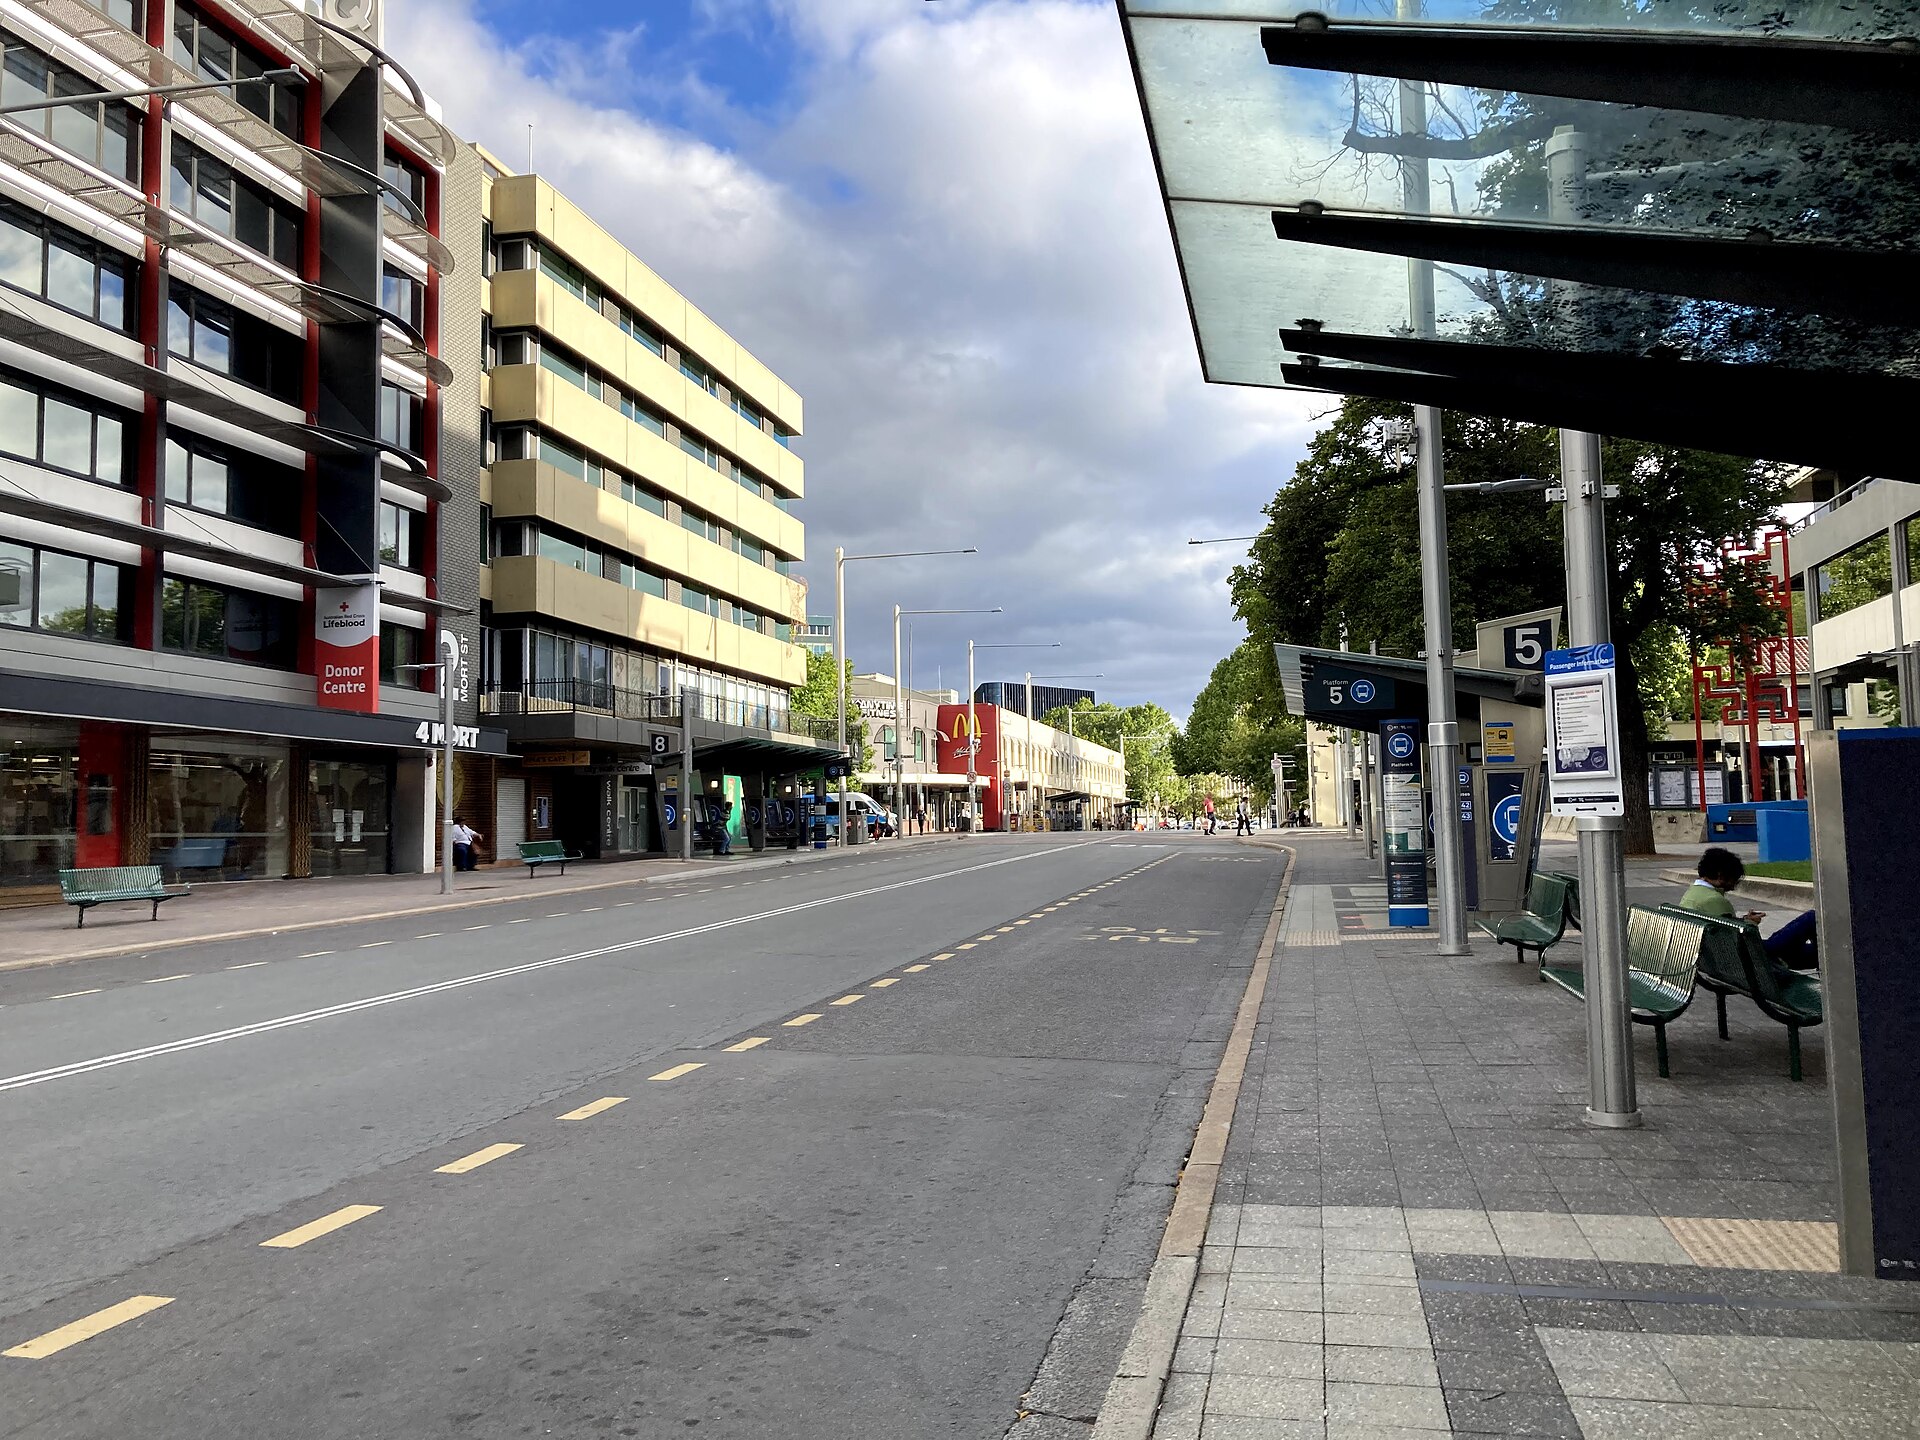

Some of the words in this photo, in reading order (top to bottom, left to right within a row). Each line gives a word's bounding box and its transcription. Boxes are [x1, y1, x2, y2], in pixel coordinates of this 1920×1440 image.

[323, 618, 366, 628] Lifeblood
[460, 633, 469, 655] ST
[1515, 628, 1542, 665] 5
[325, 664, 365, 678] Donor
[1549, 662, 1576, 670] Passenger
[1576, 658, 1609, 667] Information
[323, 681, 366, 694] Centre
[460, 658, 469, 702] MORT
[1329, 686, 1343, 705] 5
[415, 721, 430, 744] 4
[655, 736, 666, 752] 8
[616, 764, 640, 772] centre
[605, 780, 613, 806] walk
[605, 809, 613, 847] centre
